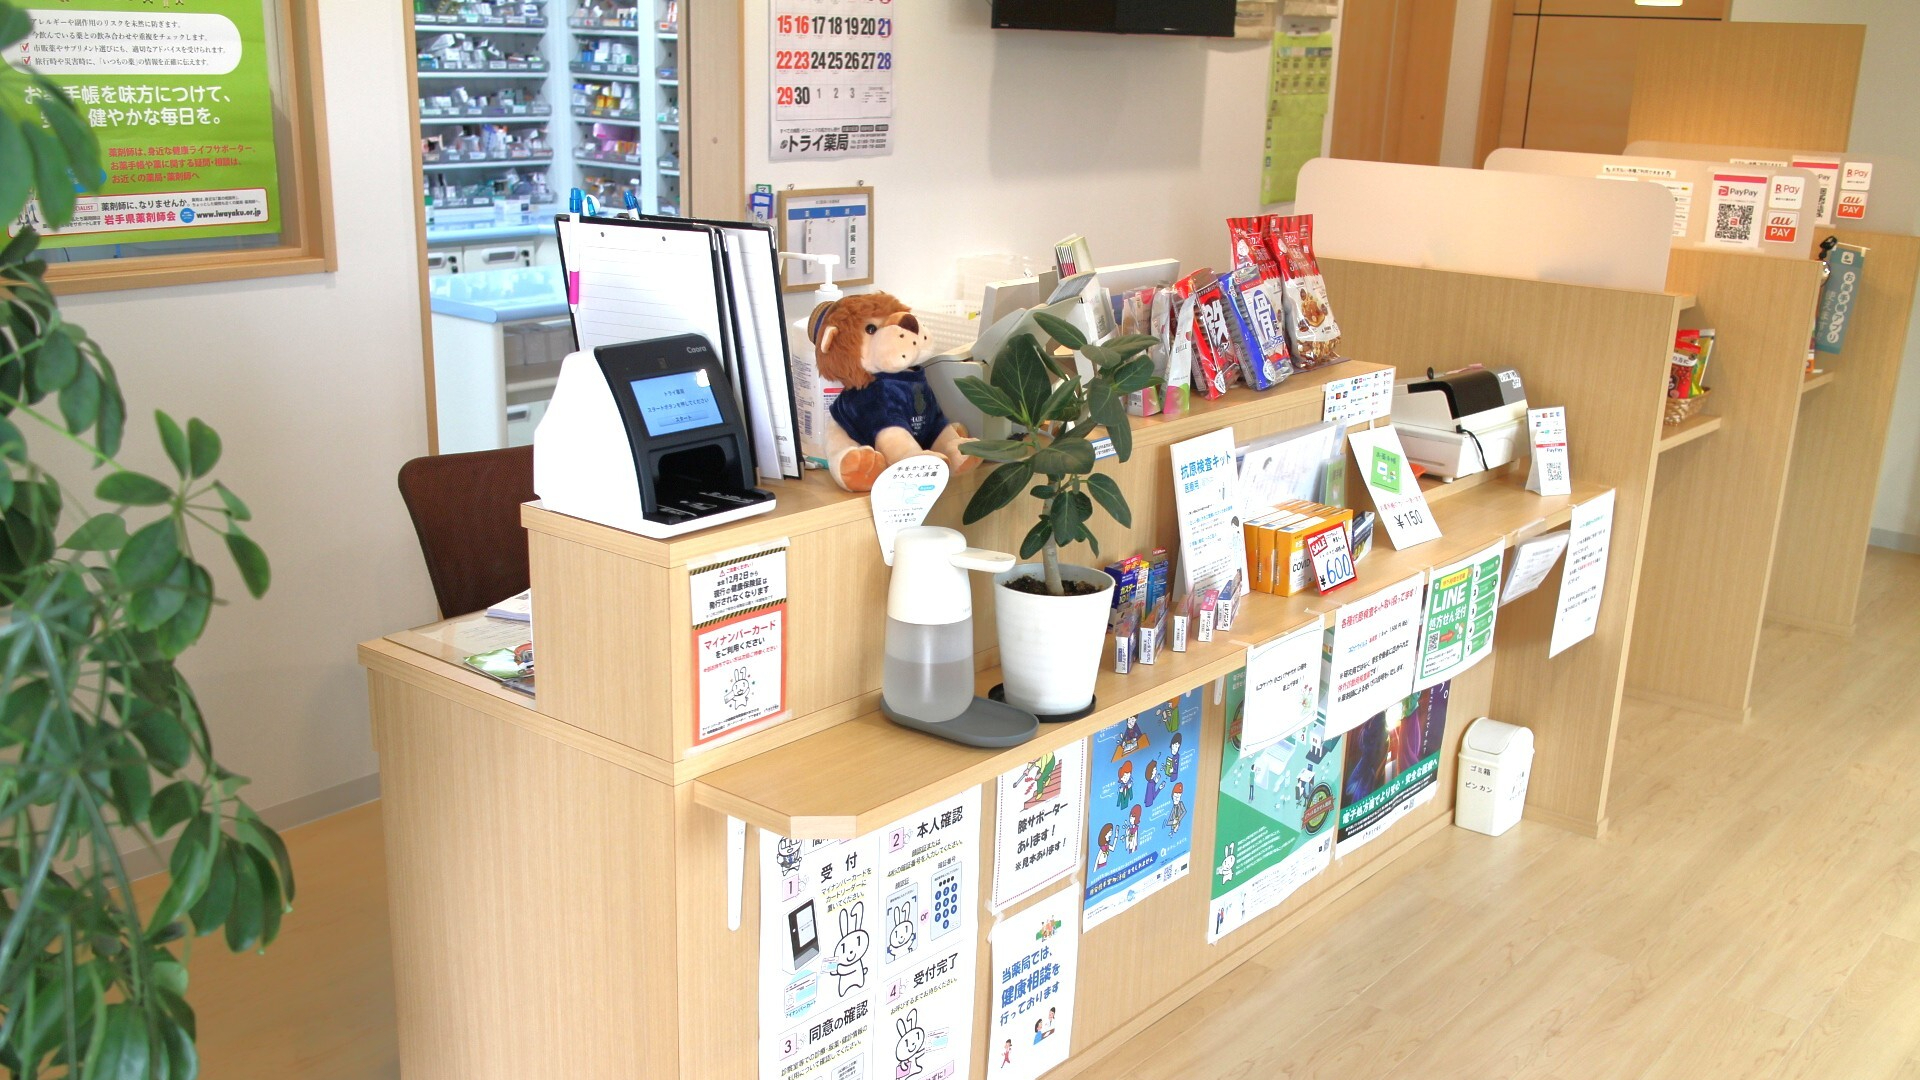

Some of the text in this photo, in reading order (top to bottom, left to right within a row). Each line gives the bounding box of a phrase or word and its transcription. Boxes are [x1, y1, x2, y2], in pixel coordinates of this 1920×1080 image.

[777, 15, 891, 36] 15 16 17 18 19 20 21
[776, 51, 891, 69] 22 23 24 25 26 27 28
[24, 85, 231, 104] お手帳を味方につけて、
[777, 86, 793, 105] 29
[794, 86, 810, 105] 30
[834, 88, 839, 98] 2
[850, 88, 855, 98] 3
[788, 134, 849, 152] トライ薬局
[112, 172, 200, 184] お近くの薬局・薬剤師へ
[1854, 169, 1868, 178] Pay
[1730, 187, 1758, 197] PayPay
[1783, 184, 1800, 194] Pay
[101, 199, 190, 212] 薬剤師に、なりませんか。
[1843, 196, 1862, 204] au
[104, 211, 176, 226] 岩手県薬剤師会
[196, 208, 262, 219] www.iwayaku.or.jp
[1771, 216, 1793, 225] au
[1770, 228, 1791, 237] PAY
[647, 397, 709, 413] スタートボタンを押してください
[897, 464, 940, 472] 手をかざして
[1180, 450, 1231, 480] 抗原検査キット
[893, 471, 938, 479] かんたん消毒
[1394, 509, 1423, 529] ¥150
[1311, 537, 1328, 554] SALE
[713, 577, 768, 599] 現行の健康保険証は
[709, 586, 770, 610] 発行されなくなります
[1432, 582, 1468, 615] LINE
[1428, 604, 1467, 631] 処方せん受付
[704, 619, 777, 650] マイナンバーカード
[715, 637, 765, 659] をご利用ください
[1470, 765, 1491, 776] ゴミ箱
[1465, 781, 1493, 793] ビン カン
[916, 806, 963, 839] 本人確認
[1017, 802, 1068, 834] 膝サポーター
[893, 834, 900, 847] 2
[1017, 824, 1056, 854] あります!
[937, 855, 956, 869] 暗証番号
[1014, 838, 1067, 871] ※見本あります!
[821, 851, 858, 884] 受付
[788, 881, 793, 894] 1
[821, 867, 872, 896] マイナンバーカードを
[825, 880, 867, 904] カードリーダーに
[827, 891, 865, 914] 置いてください。
[920, 911, 929, 921] or
[913, 952, 959, 989] 受付完了
[1002, 945, 1053, 984] 当薬局では、
[890, 984, 897, 997] 4
[1001, 963, 1061, 1009] 健康相談を
[1000, 981, 1060, 1027] 行っております
[809, 1000, 869, 1044] 同意の確認
[784, 1039, 792, 1054] 3
